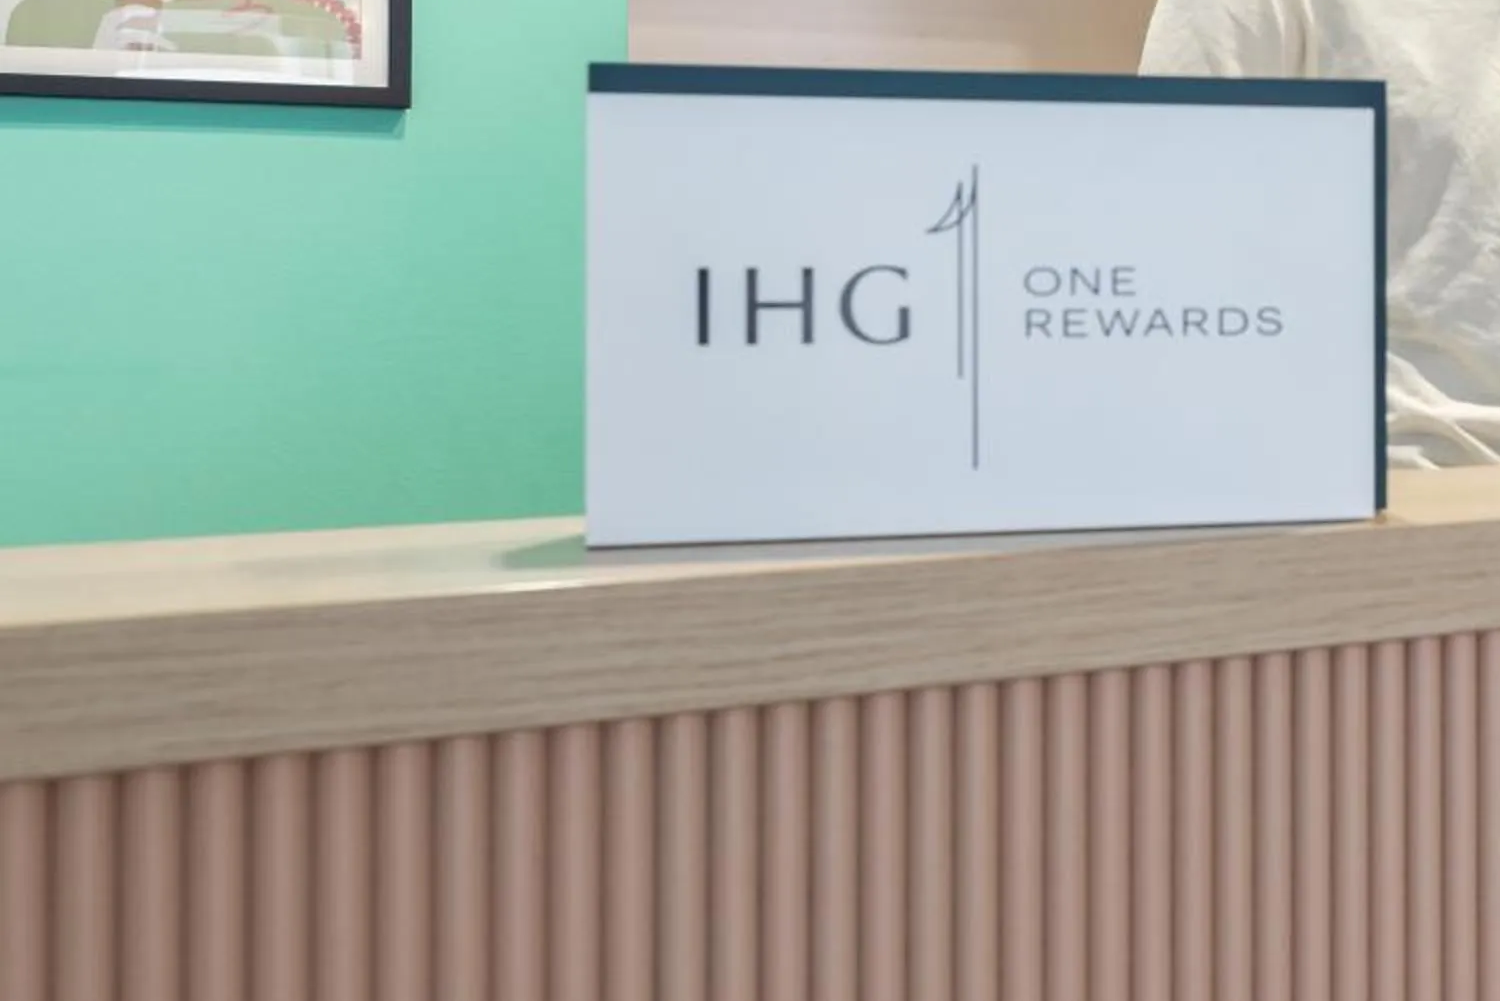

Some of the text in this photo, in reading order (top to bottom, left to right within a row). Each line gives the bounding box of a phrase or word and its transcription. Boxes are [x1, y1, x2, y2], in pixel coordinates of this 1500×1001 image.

[1023, 266, 1136, 297] ONE
[695, 265, 912, 347] IHG
[1024, 307, 1285, 338] REWARDS
